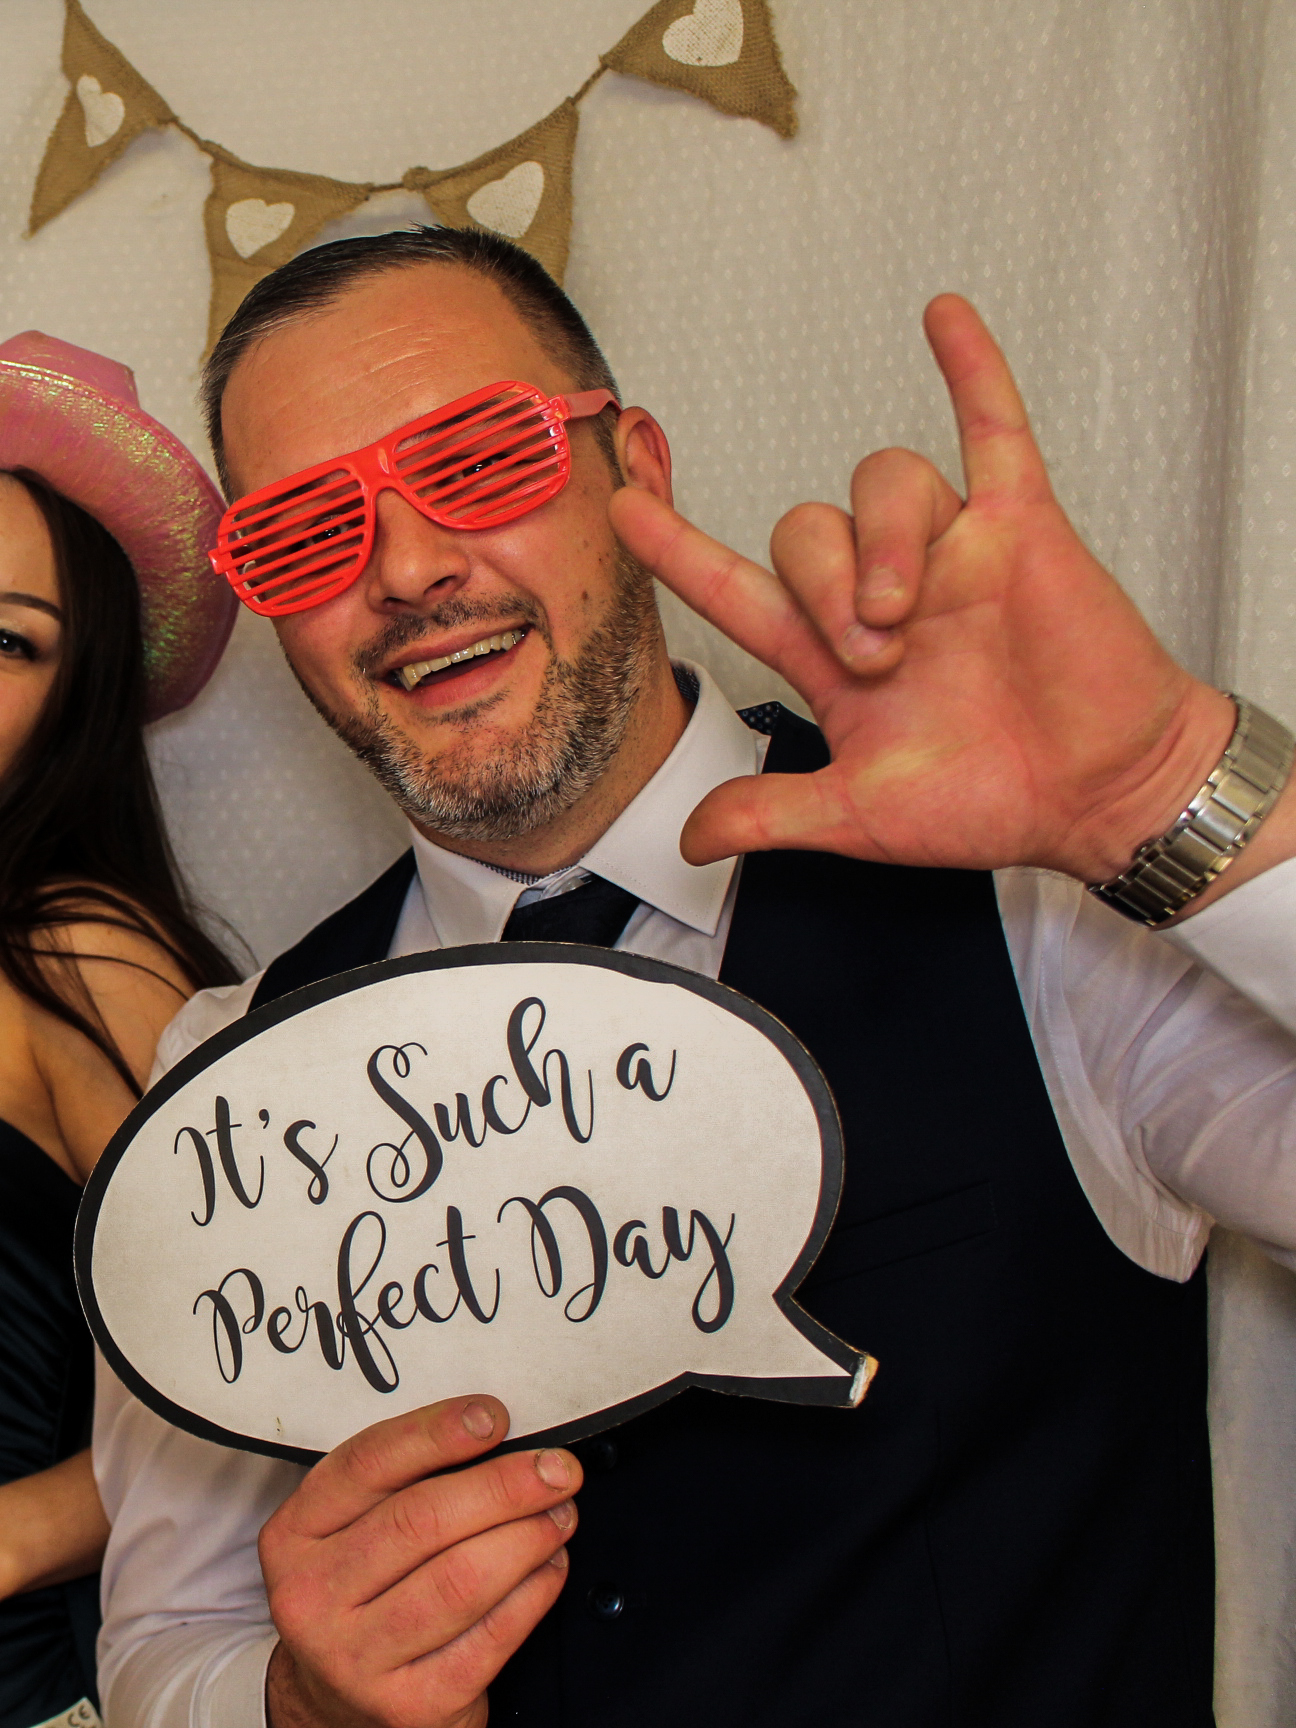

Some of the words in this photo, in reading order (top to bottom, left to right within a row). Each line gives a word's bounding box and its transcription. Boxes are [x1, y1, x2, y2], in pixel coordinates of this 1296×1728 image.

[172, 1094, 340, 1228] It's
[365, 995, 595, 1205] Such
[615, 1041, 678, 1103] a
[191, 1205, 503, 1395] Perfect
[495, 1184, 737, 1335] Day
